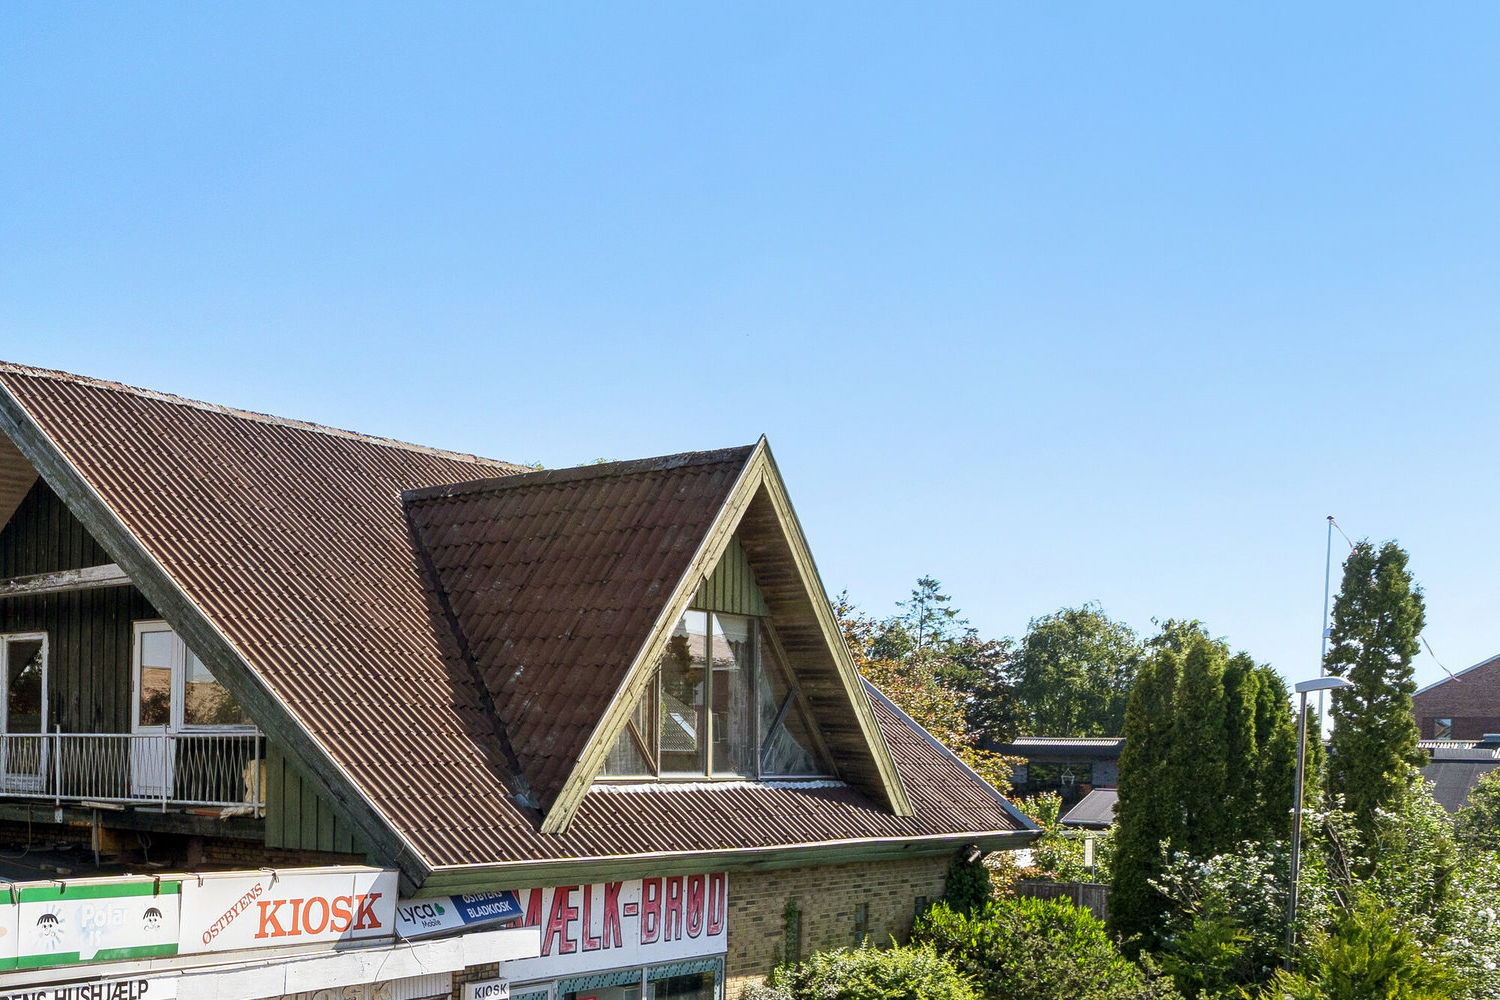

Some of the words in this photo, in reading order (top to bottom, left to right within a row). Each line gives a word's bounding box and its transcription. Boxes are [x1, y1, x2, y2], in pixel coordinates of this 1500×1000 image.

[254, 892, 382, 939] KIOSK
[397, 902, 436, 925] Lyca
[466, 900, 513, 919] BLADKIOSK
[422, 919, 442, 929] Mobile
[474, 983, 507, 999] KIOSK
